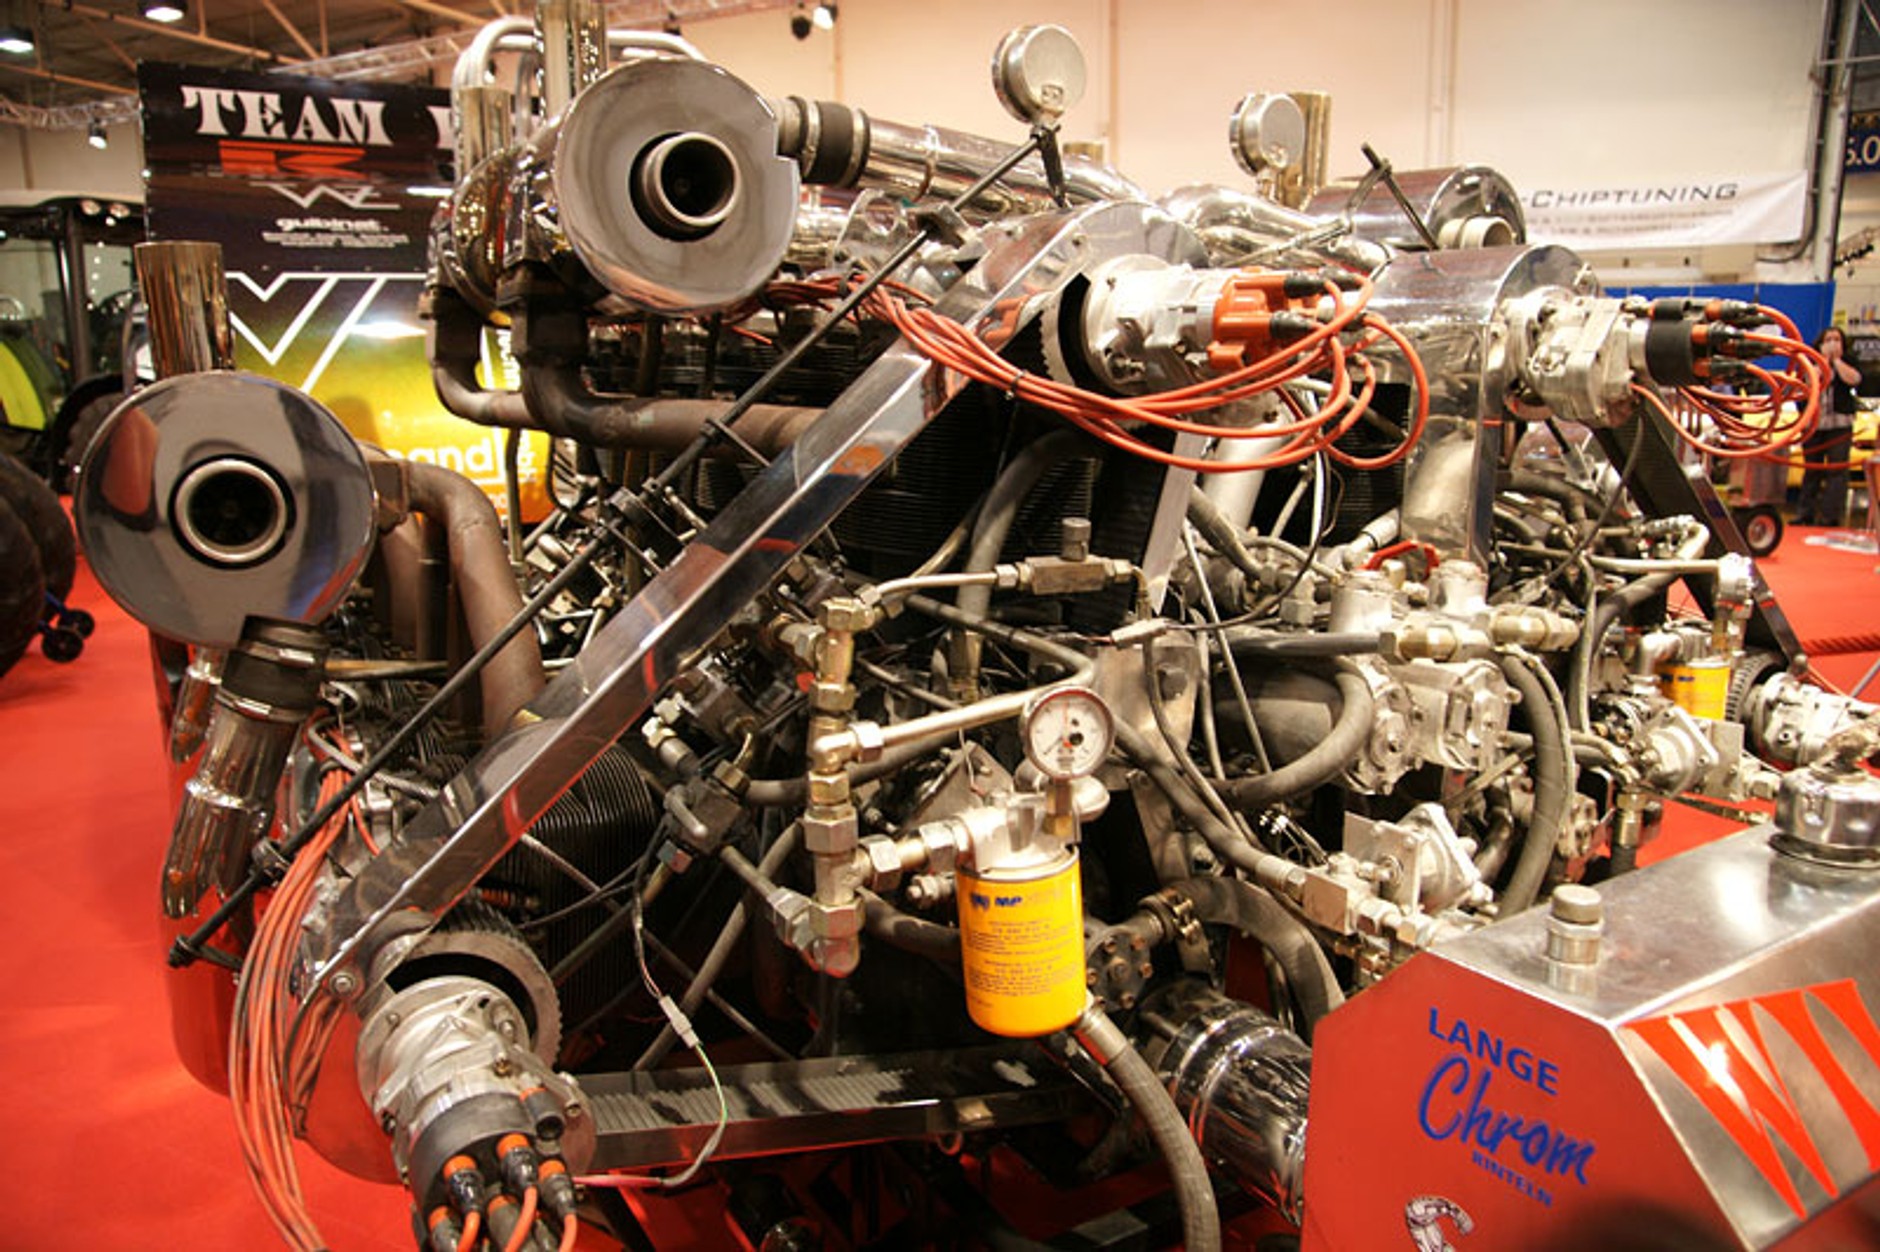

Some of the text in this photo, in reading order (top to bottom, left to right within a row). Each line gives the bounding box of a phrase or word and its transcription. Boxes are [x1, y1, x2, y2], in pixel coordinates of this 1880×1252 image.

[181, 85, 394, 146] TEAM
[1428, 1006, 1560, 1097] LANGE
[1418, 1054, 1596, 1187] Chrom
[1471, 1150, 1554, 1209] RINTELN
